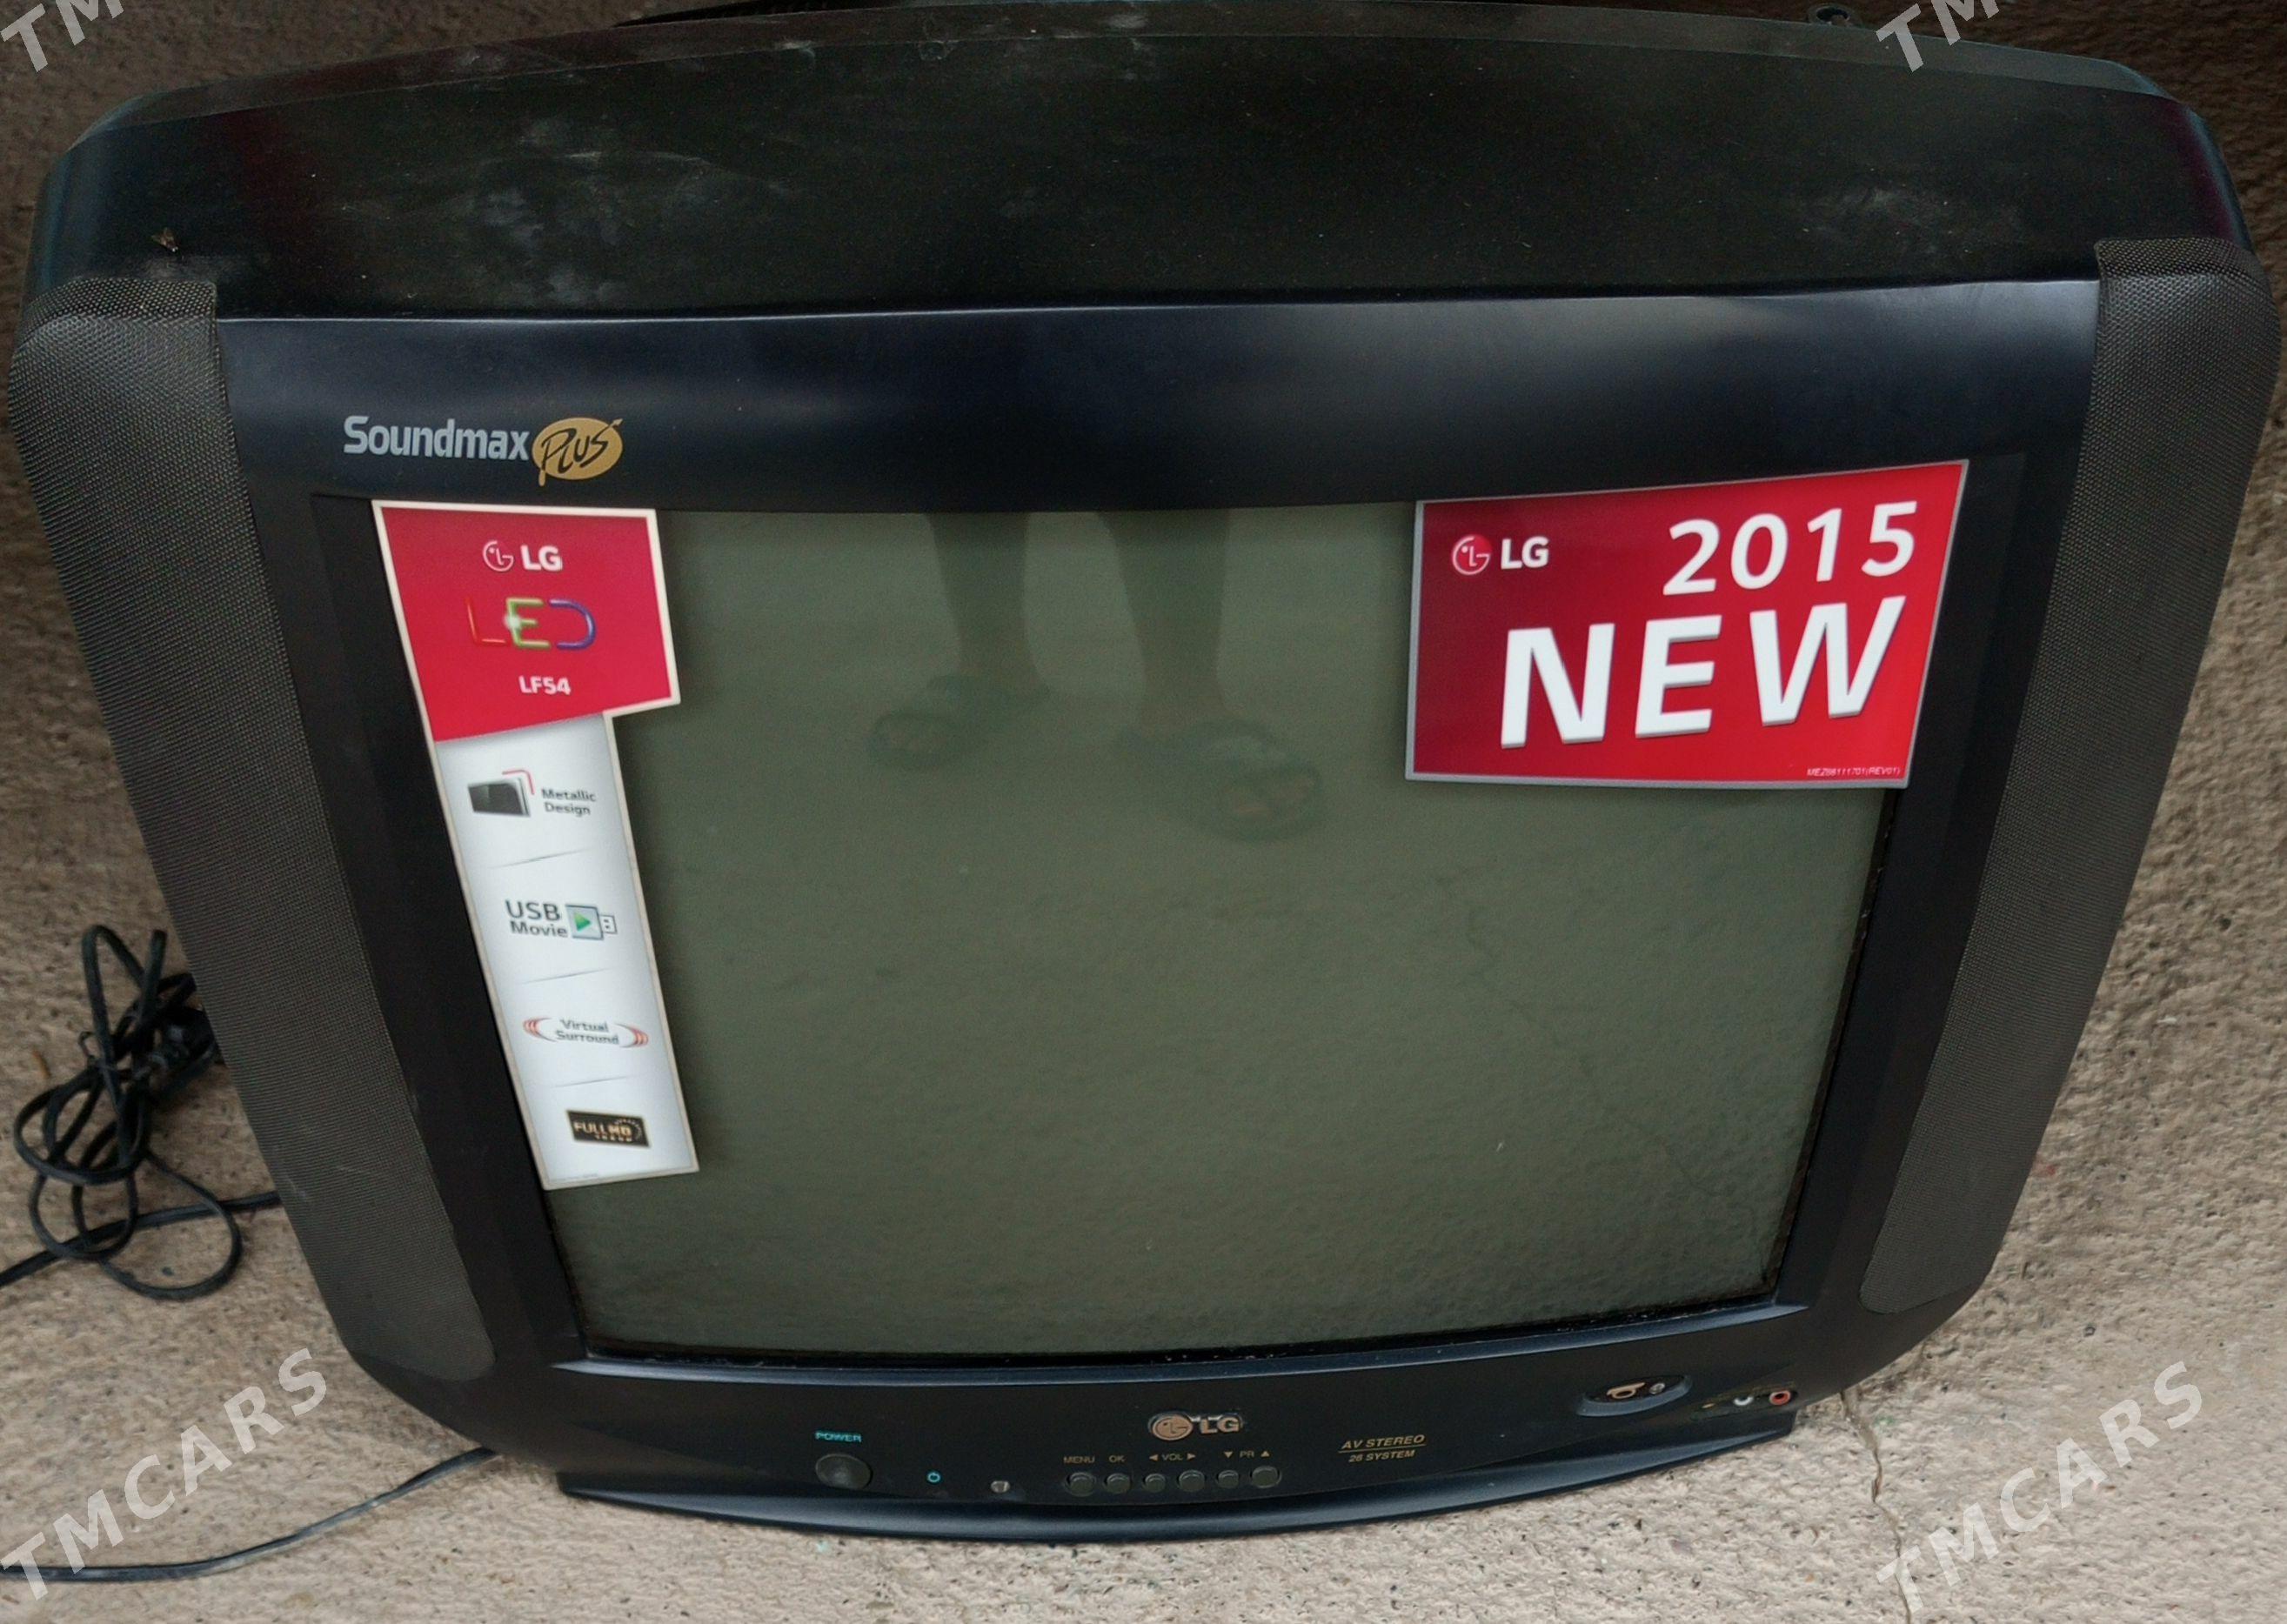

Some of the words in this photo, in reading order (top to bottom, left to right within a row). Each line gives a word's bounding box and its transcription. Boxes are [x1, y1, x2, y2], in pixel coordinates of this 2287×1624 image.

[343, 415, 530, 461] Soundmax
[1500, 536, 1549, 570] LG
[1662, 500, 1917, 595] 2015
[520, 545, 563, 571] LG
[465, 597, 596, 651] LED
[1500, 595, 1907, 749] NEW
[518, 675, 571, 695] LF54
[541, 788, 597, 803] Metallic
[545, 802, 591, 817] Design
[505, 899, 561, 921] USB
[510, 921, 568, 938] Movie
[559, 1019, 609, 1033] Virtual
[556, 1030, 619, 1045] Surround
[1200, 1415, 1240, 1434] LG
[815, 1431, 862, 1443] POWER
[1341, 1440, 1363, 1450] AV
[1365, 1434, 1425, 1448] STEREO
[1064, 1455, 1095, 1464] MENU
[1109, 1454, 1125, 1464] OK
[1161, 1453, 1183, 1461] VOL
[1366, 1450, 1416, 1461] SYSTEM
